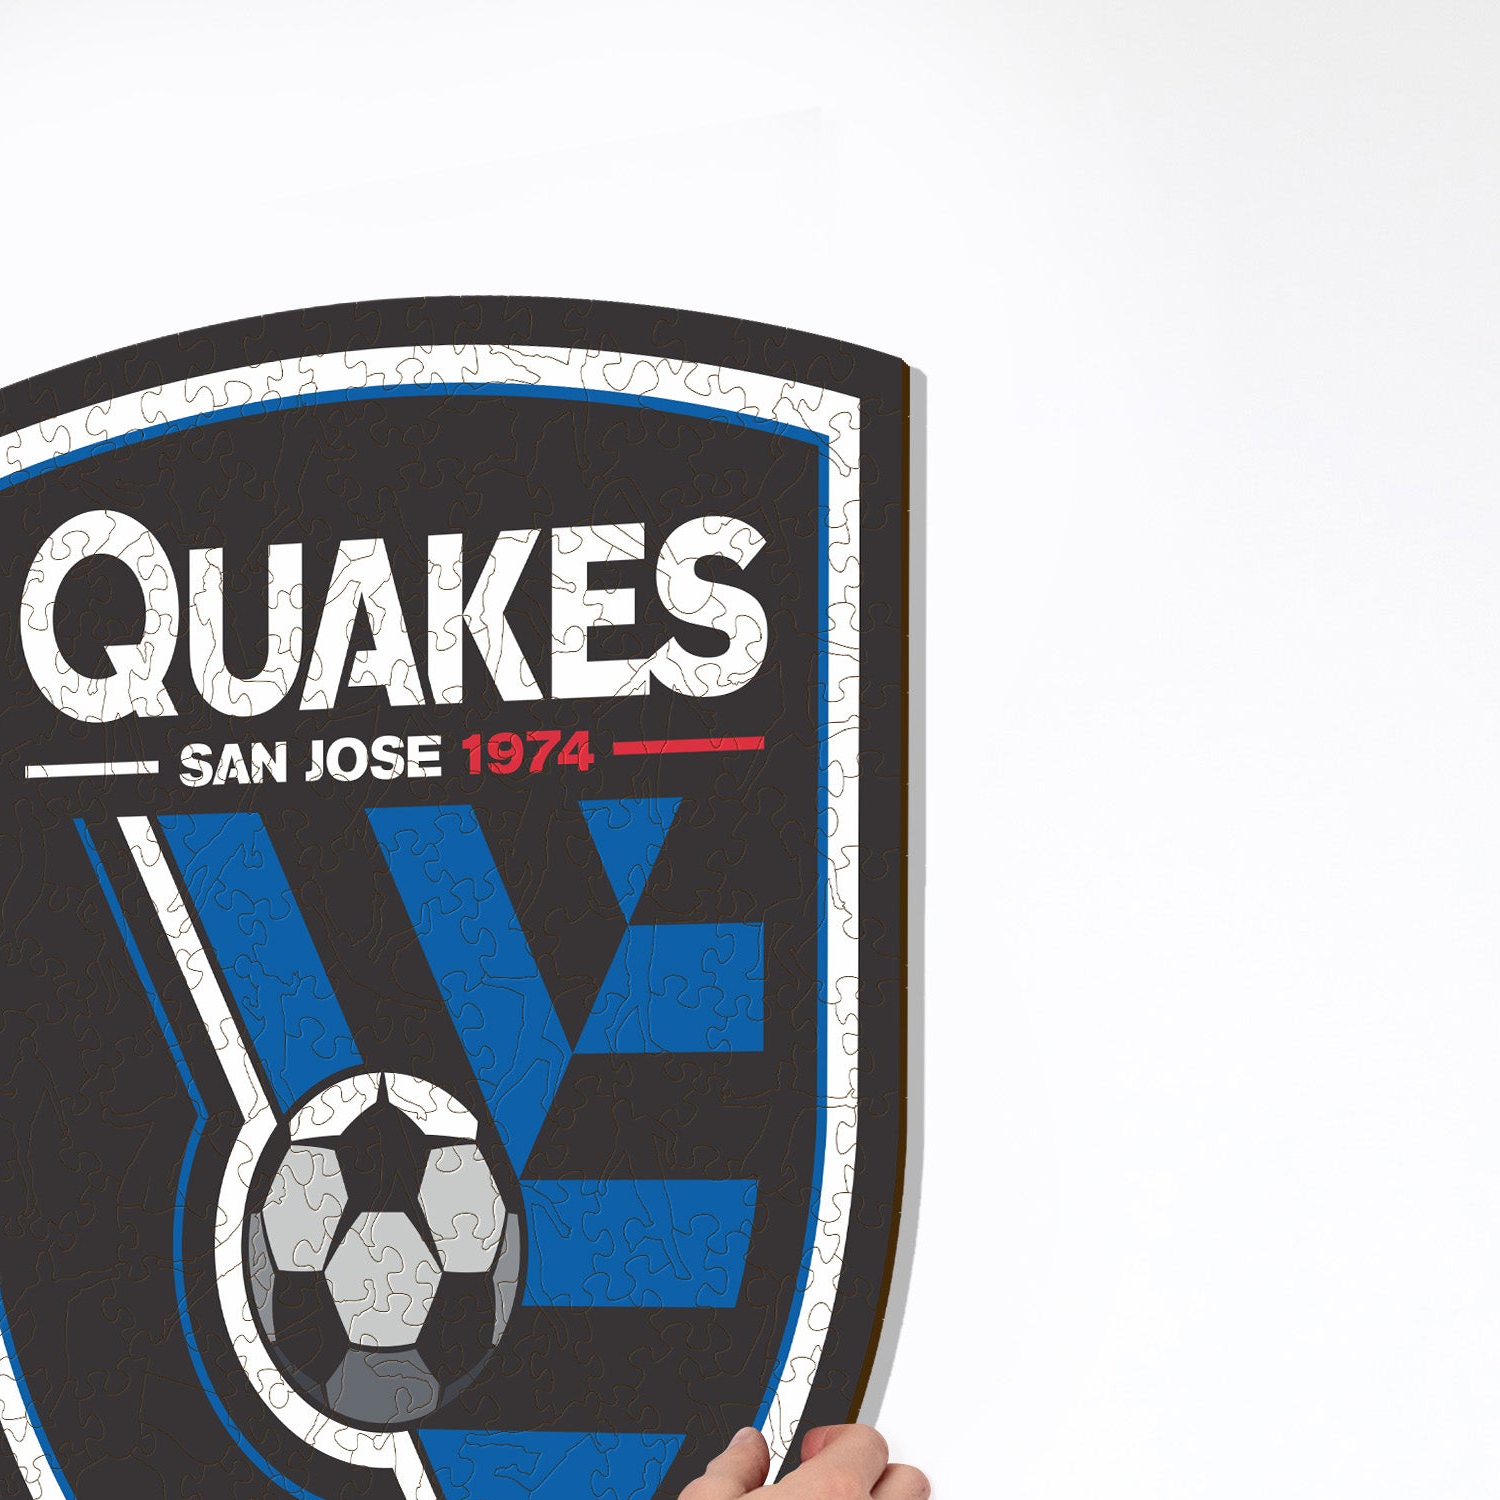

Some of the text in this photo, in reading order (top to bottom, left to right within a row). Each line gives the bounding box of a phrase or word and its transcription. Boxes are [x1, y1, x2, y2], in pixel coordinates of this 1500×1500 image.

[20, 510, 768, 723] QUAKES
[179, 730, 595, 787] SAN JOSE 1974
